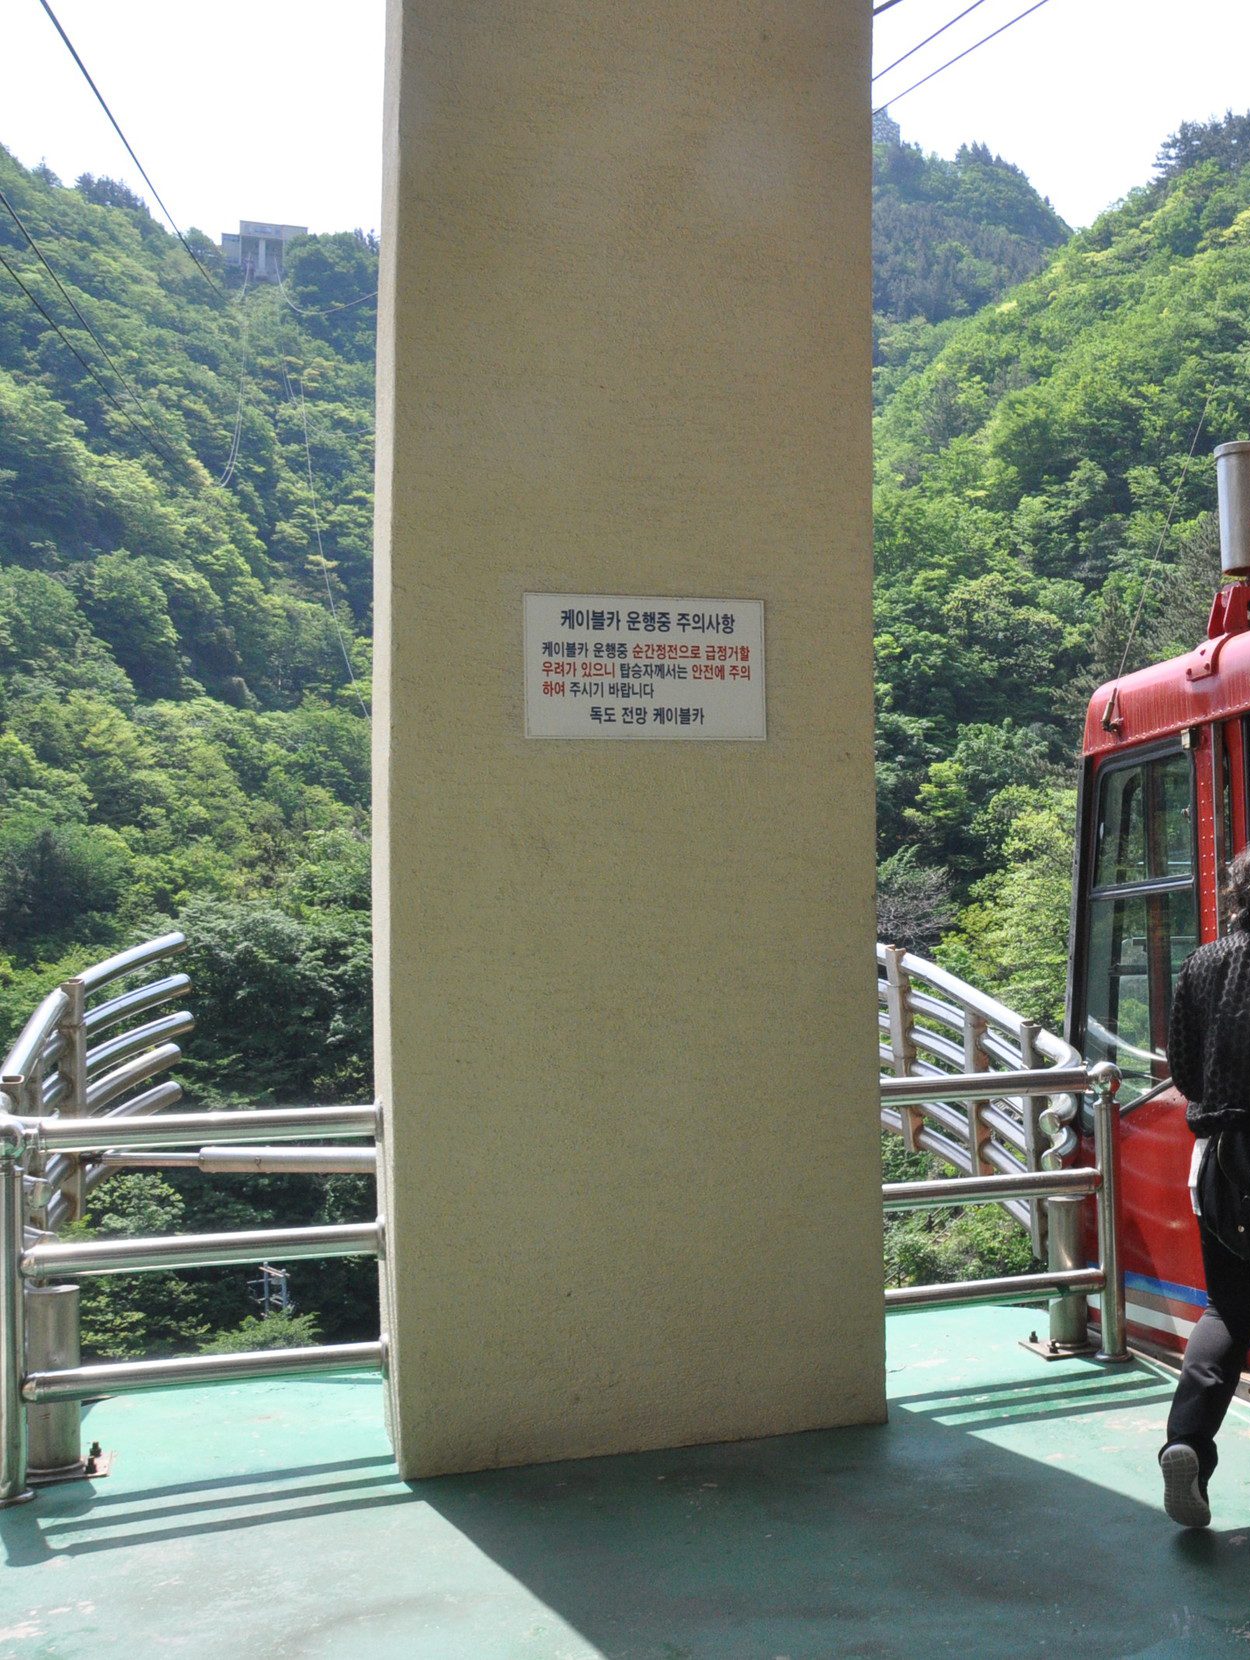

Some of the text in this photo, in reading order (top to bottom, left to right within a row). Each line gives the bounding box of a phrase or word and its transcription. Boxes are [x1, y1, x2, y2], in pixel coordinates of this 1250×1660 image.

[560, 609, 735, 634] 케이블카 운행중 주의사항
[541, 641, 750, 662] 케이블카 운행중 순간정전으로 급정거할
[541, 661, 751, 681] 우려가 있으니 탑승자께서는 안전에 주의
[542, 681, 654, 699] 하여 주시기 바랍니다
[589, 706, 705, 725] 독도 전망 케이블카
